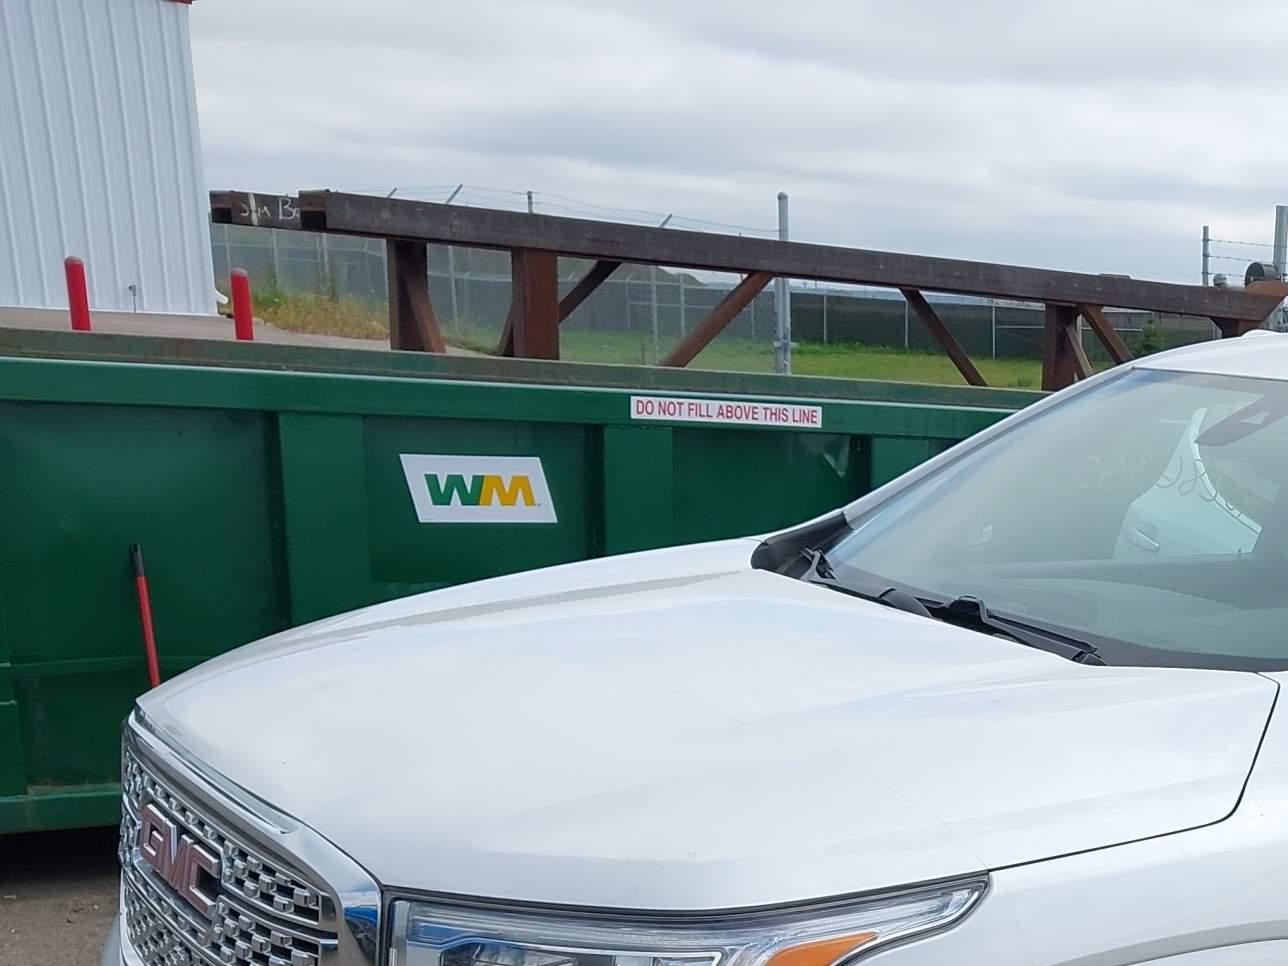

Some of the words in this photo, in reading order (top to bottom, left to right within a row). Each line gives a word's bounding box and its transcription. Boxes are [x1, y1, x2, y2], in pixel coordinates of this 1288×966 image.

[636, 399, 653, 415] DO
[658, 401, 684, 417] NOT
[688, 403, 713, 418] FILL
[716, 404, 759, 421] ABOVE
[762, 407, 789, 422] THIS
[792, 409, 818, 424] LINE
[424, 473, 536, 507] WM
[139, 803, 220, 922] GMC
